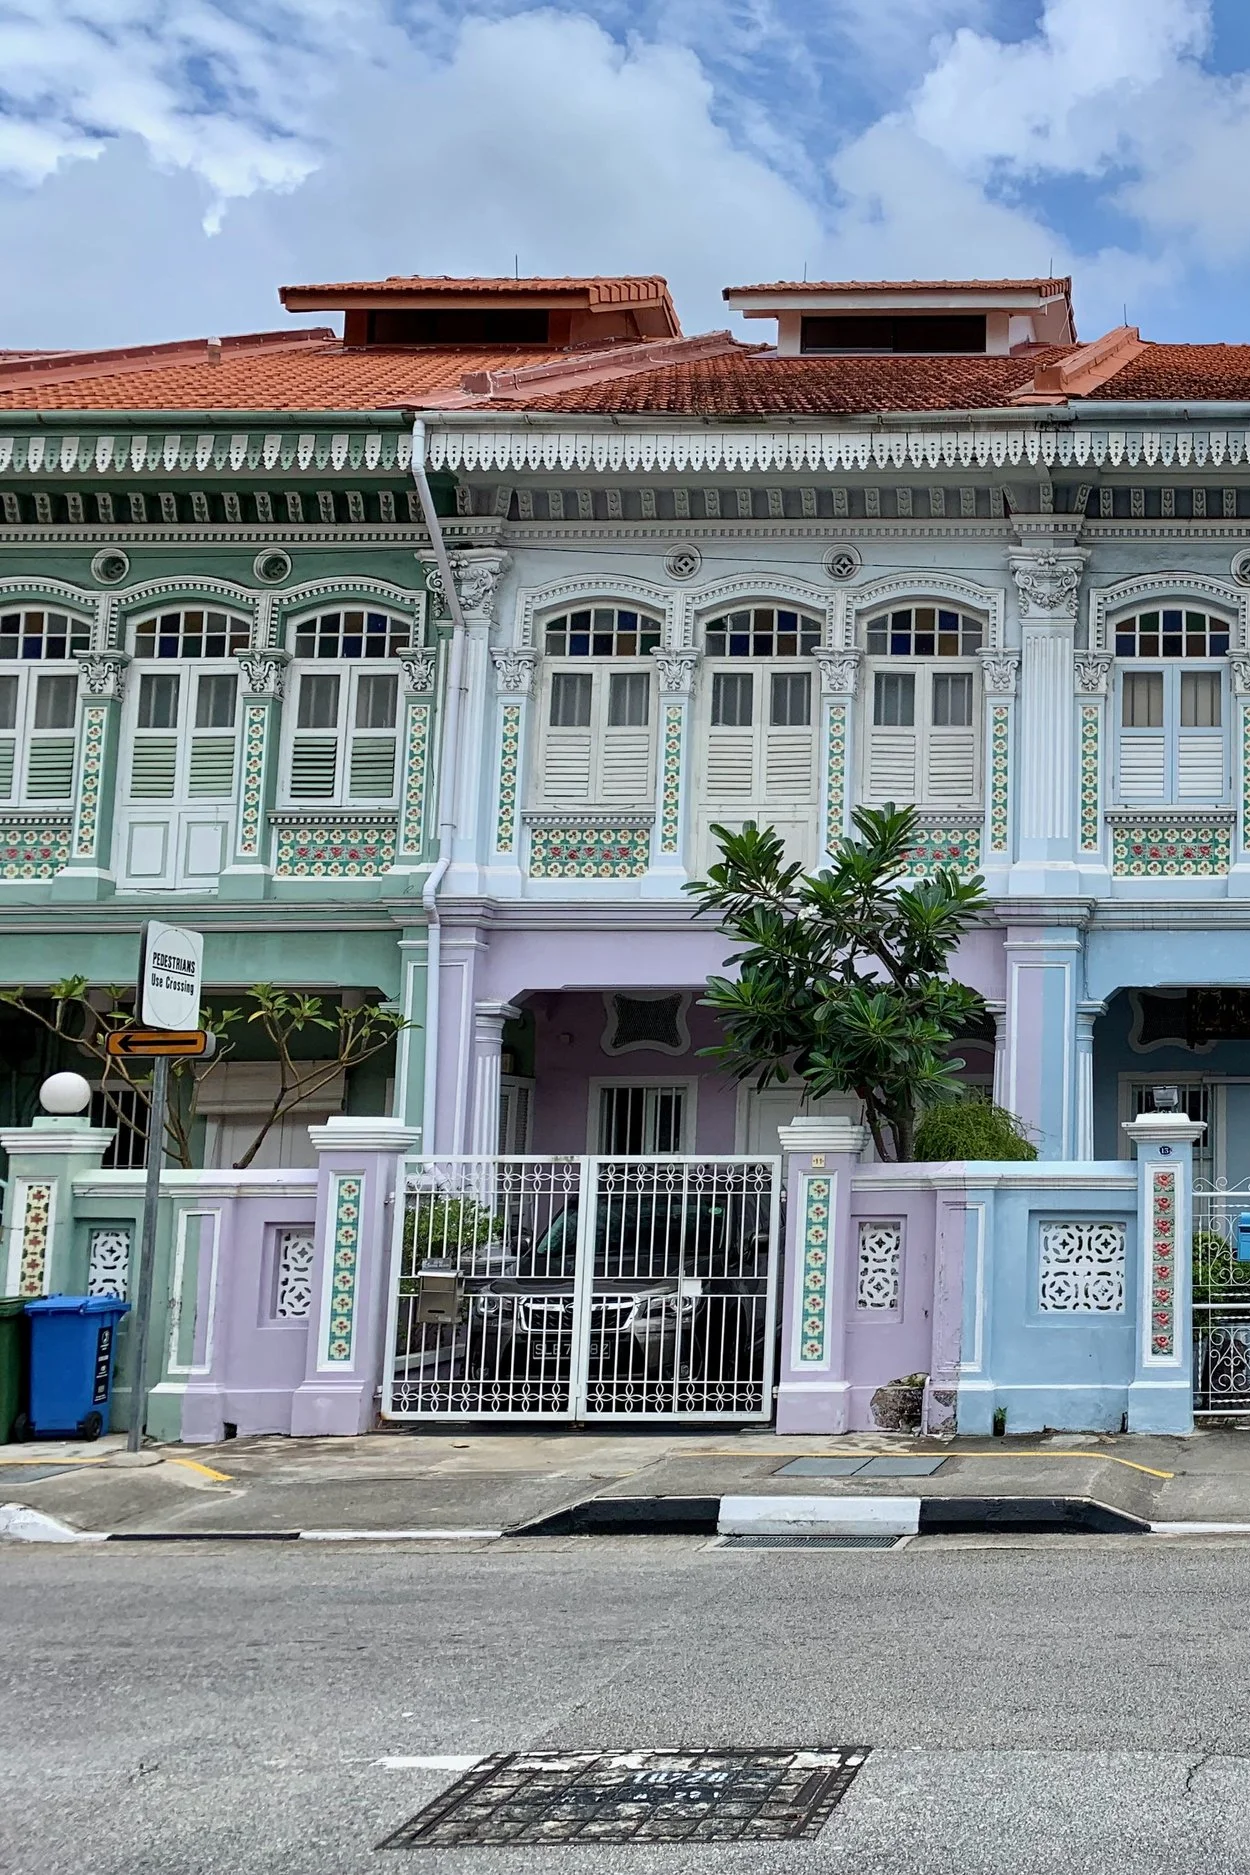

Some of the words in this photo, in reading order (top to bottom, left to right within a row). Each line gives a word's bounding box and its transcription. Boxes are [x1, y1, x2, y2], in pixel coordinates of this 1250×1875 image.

[152, 951, 195, 974] PEDESTRIANS
[151, 972, 163, 988] Use
[165, 976, 194, 996] Crossing
